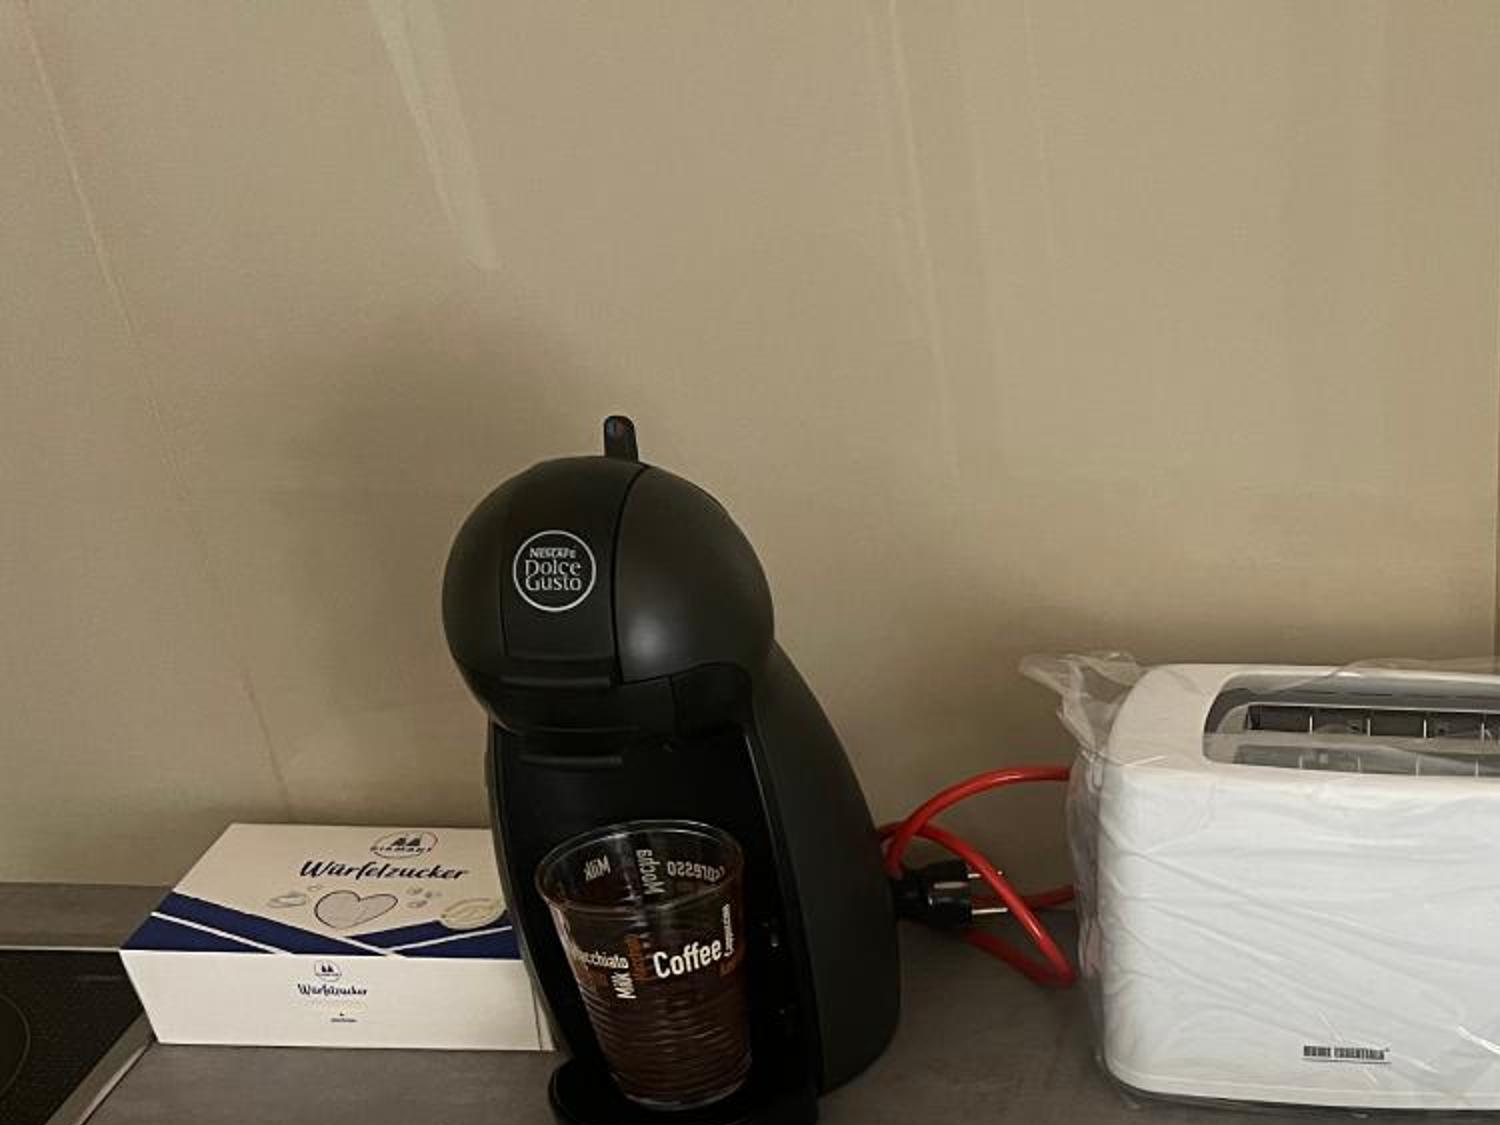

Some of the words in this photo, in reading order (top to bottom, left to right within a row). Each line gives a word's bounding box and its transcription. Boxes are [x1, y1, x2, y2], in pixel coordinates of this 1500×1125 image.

[525, 559, 582, 577] Dolce
[525, 574, 583, 591] Gusto
[653, 940, 722, 978] Coffee
